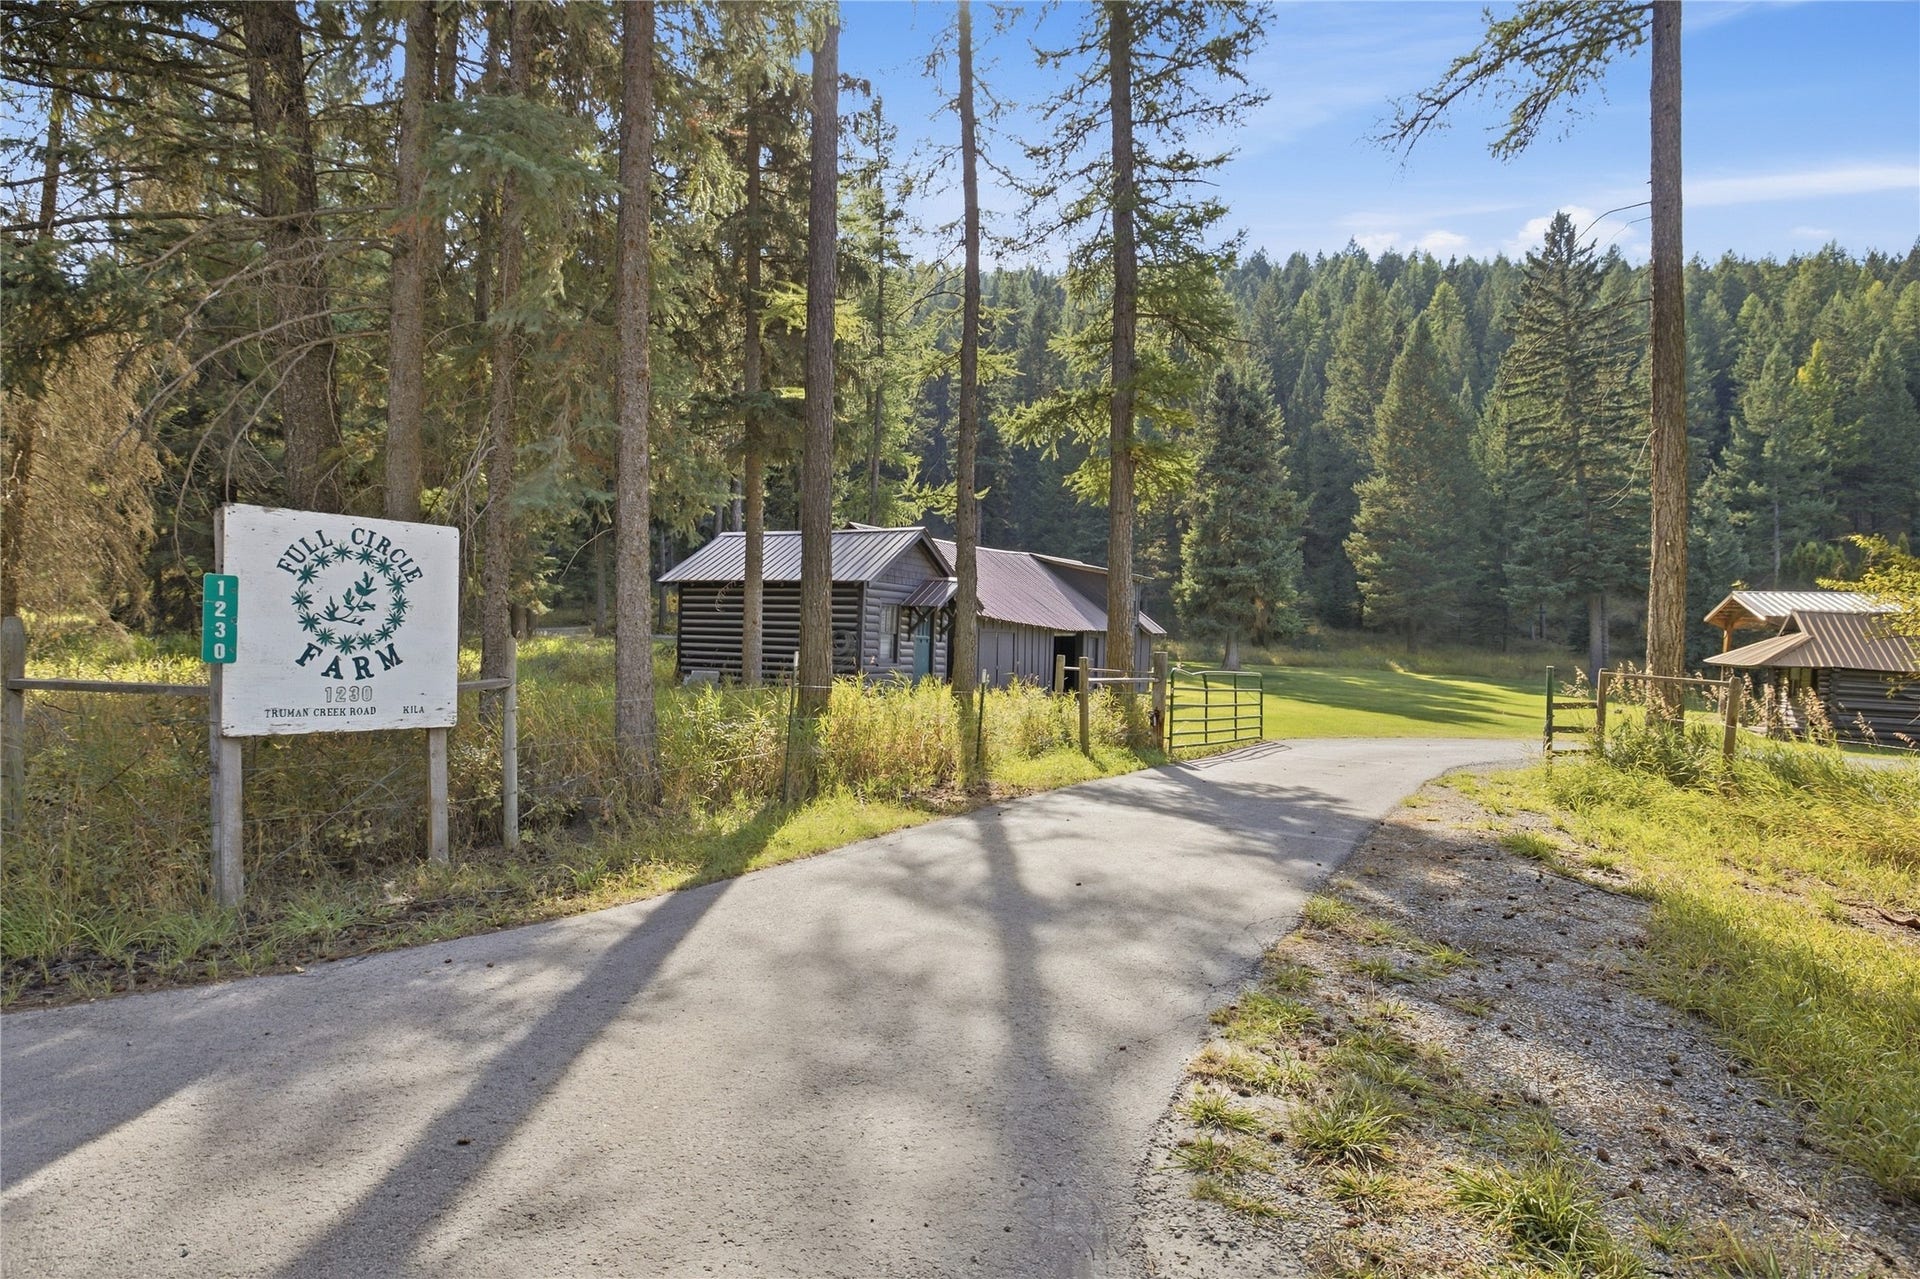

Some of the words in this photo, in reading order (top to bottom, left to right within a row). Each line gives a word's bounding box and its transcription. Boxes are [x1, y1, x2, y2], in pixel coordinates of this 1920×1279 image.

[276, 529, 334, 576] FULL
[350, 527, 424, 584] CIRCLE
[213, 580, 226, 660] 1230
[295, 643, 403, 681] FARM
[265, 708, 309, 718] TRUMAN
[313, 708, 347, 717] CREEK
[350, 706, 377, 716] ROAD
[403, 706, 425, 714] KILA
[324, 686, 373, 703] 1230
